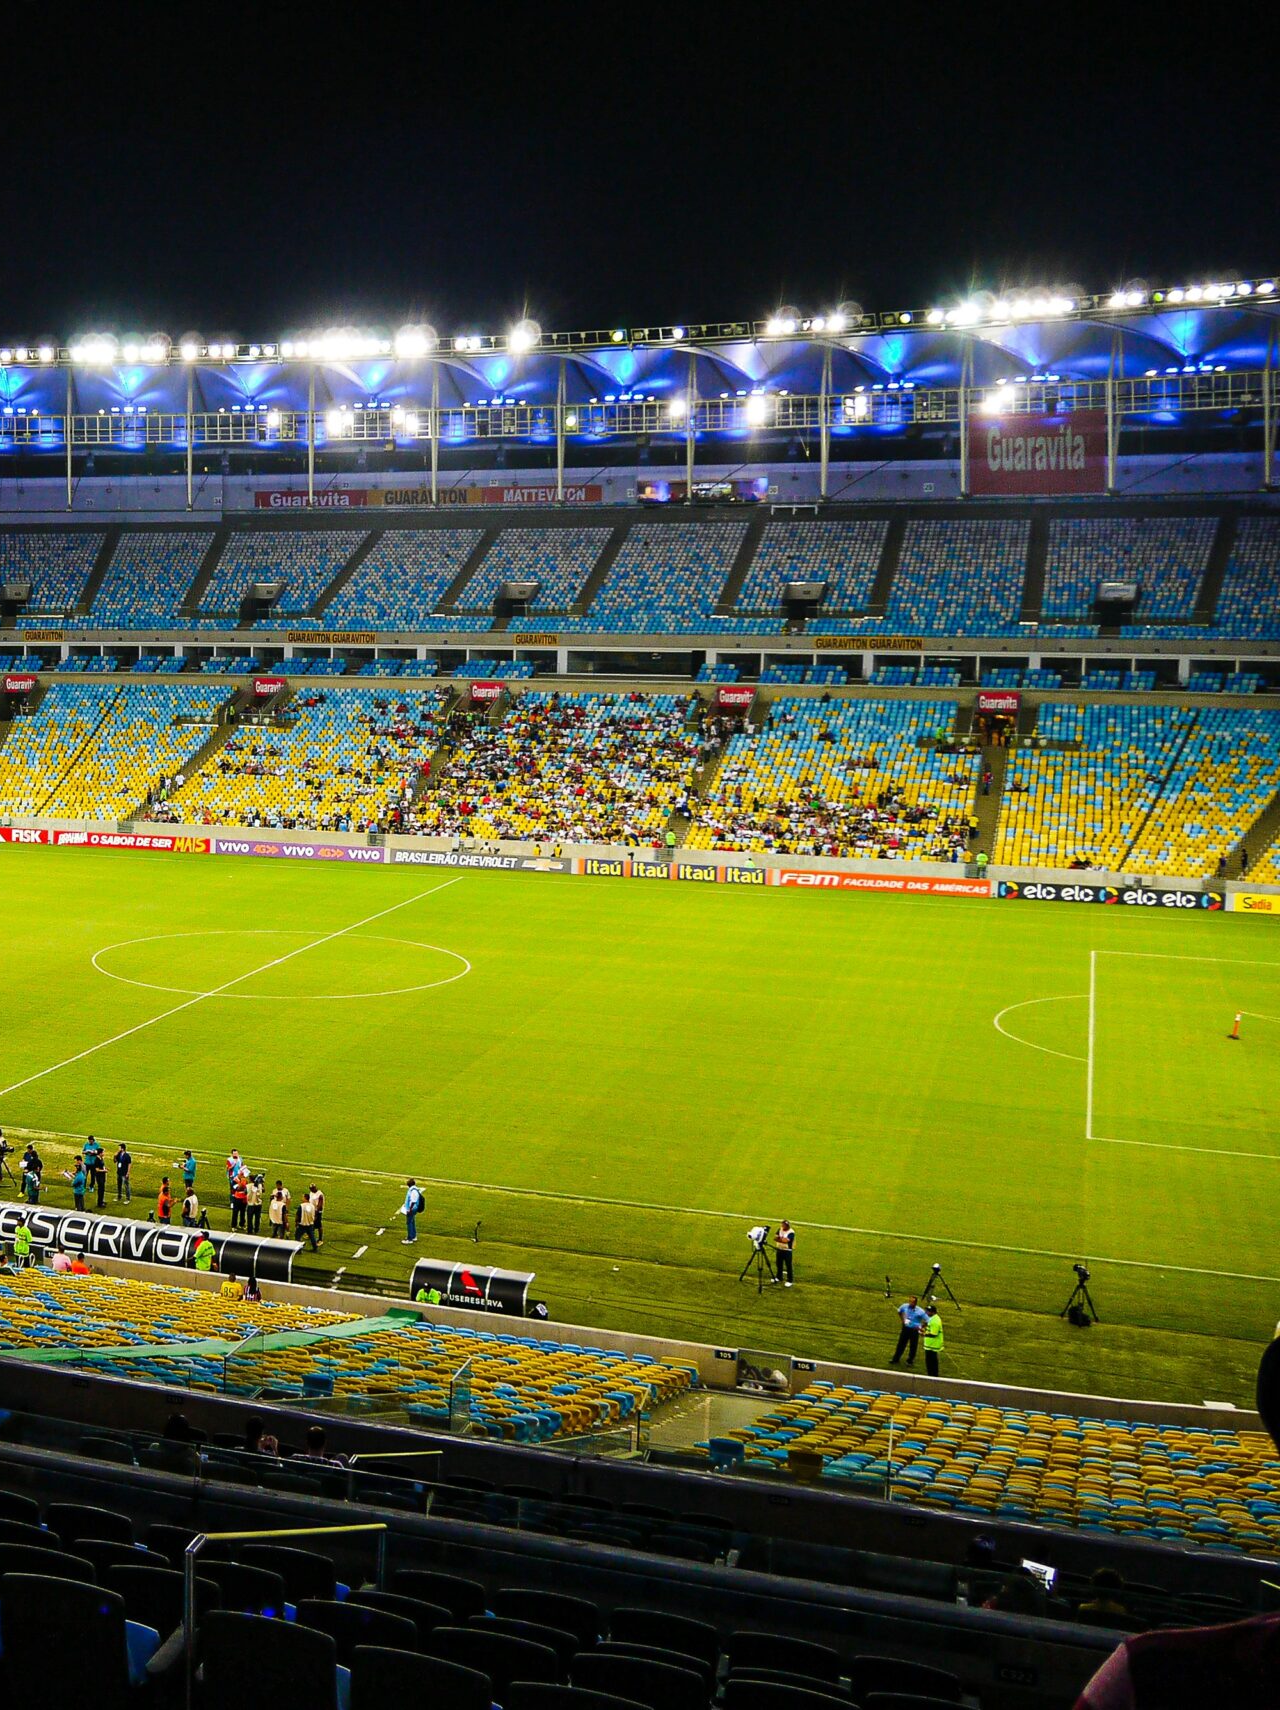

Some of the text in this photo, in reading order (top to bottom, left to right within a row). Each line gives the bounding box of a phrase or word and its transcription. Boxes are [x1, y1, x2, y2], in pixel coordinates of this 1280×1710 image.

[987, 424, 1085, 471] Guaravita
[270, 492, 349, 508] Guaravita
[504, 487, 586, 502] MATTEVTON
[25, 631, 63, 641] GUARAVITON
[288, 632, 376, 643] GUARAVITON GUARAVITON
[515, 635, 557, 645] GUARAVITON
[816, 638, 923, 650] GUARAVITON GUARAVITON
[6, 678, 35, 691] Guaravit
[255, 681, 284, 693] Guaravit
[472, 686, 501, 698] Guaravit
[979, 696, 1017, 709] Guaravita
[11, 829, 41, 842] FISK
[58, 832, 206, 853] BRAHMA O SABOR DE SER MAIS
[395, 851, 518, 869] BRASILEIRÃO CHEVROLET
[586, 860, 763, 884] Itaú Itaú Itaú Itaú
[843, 878, 905, 890] FACULDADE
[906, 882, 929, 891] DAS
[931, 883, 988, 894] AMÉRICAS
[1243, 897, 1272, 910] Sadia
[797, 1362, 810, 1370] 106
